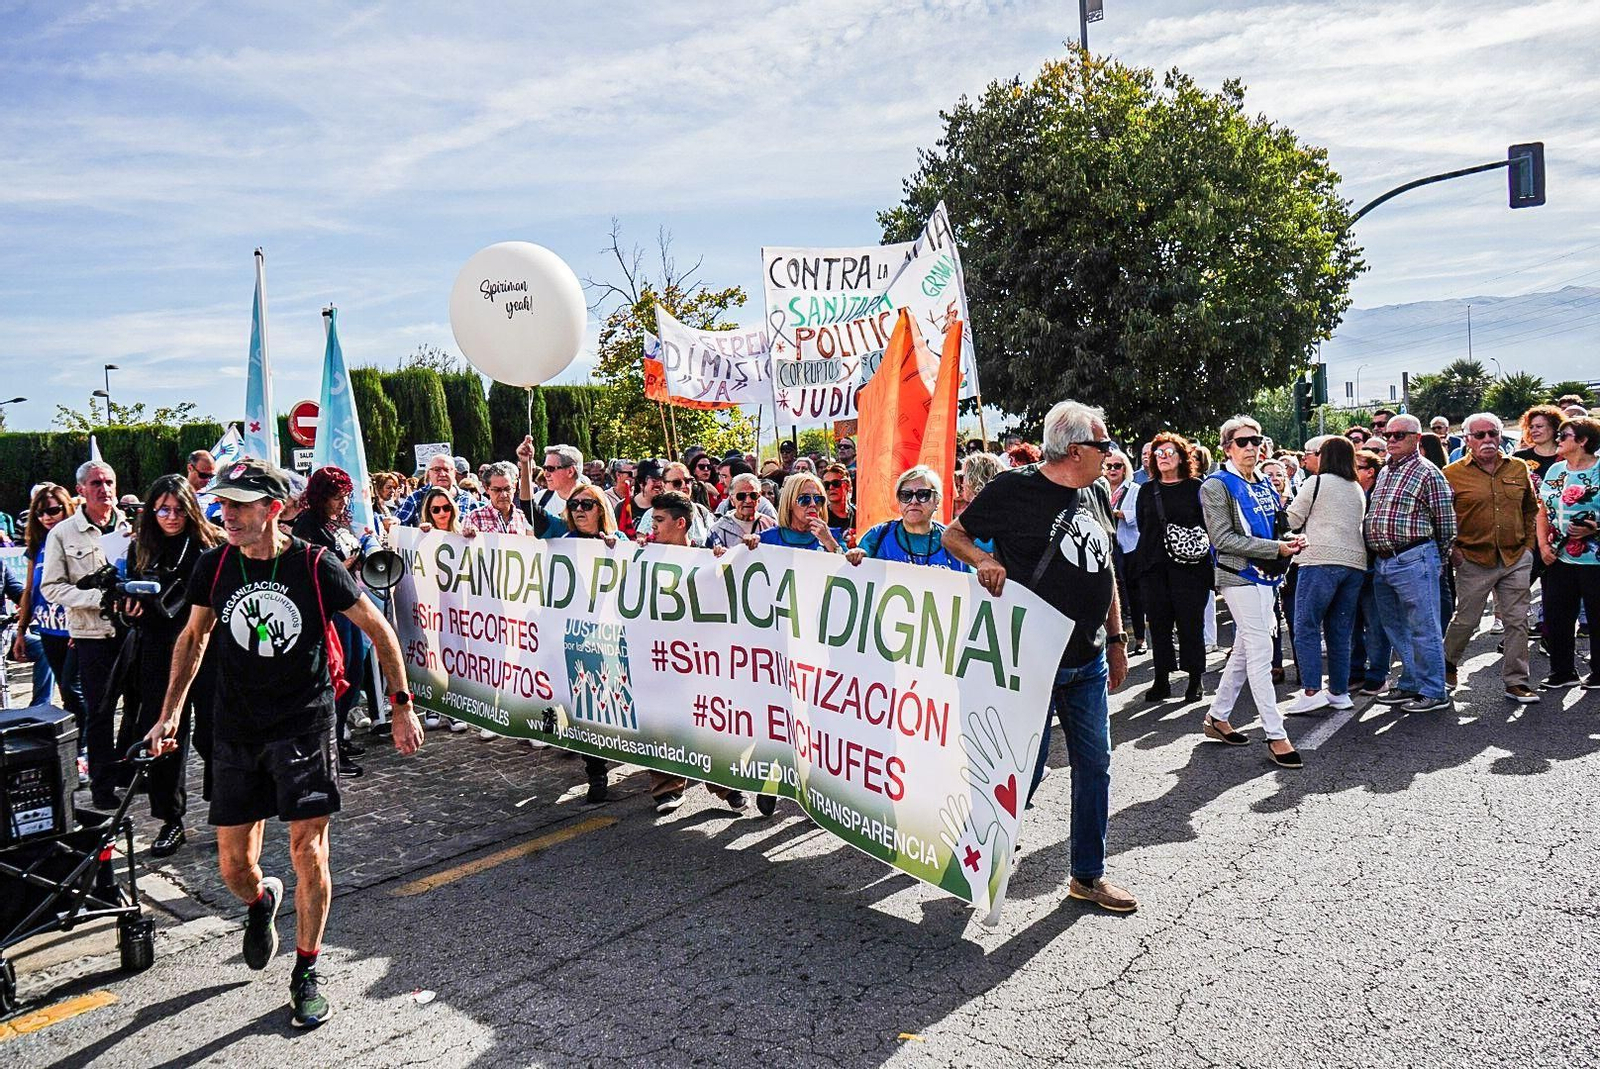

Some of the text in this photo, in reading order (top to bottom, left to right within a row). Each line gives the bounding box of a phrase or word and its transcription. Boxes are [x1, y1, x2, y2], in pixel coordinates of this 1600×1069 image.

[479, 279, 529, 303] Spiriman
[769, 255, 871, 290] CONTRA
[877, 264, 888, 279] LA
[505, 295, 534, 319] yeah!
[780, 361, 839, 388] CORRUPTOS
[221, 581, 289, 624] ORGANIZACION
[434, 543, 576, 609] SANIDAD
[588, 549, 801, 639] PÚBLICA
[818, 575, 1027, 692] DIGNA!
[412, 602, 539, 653] #Sin RECORTES
[565, 618, 627, 642] JUSTICIA
[406, 639, 554, 700] #Sin CORRUPTOS
[584, 641, 629, 658] SANIDAD
[651, 640, 950, 747] #Sin PRIVATIZACIÓN
[692, 694, 906, 802] #Sin ENCHUFES
[441, 692, 510, 727] +PROFESIONALES
[806, 787, 940, 870] +TRANSPARENCIA
